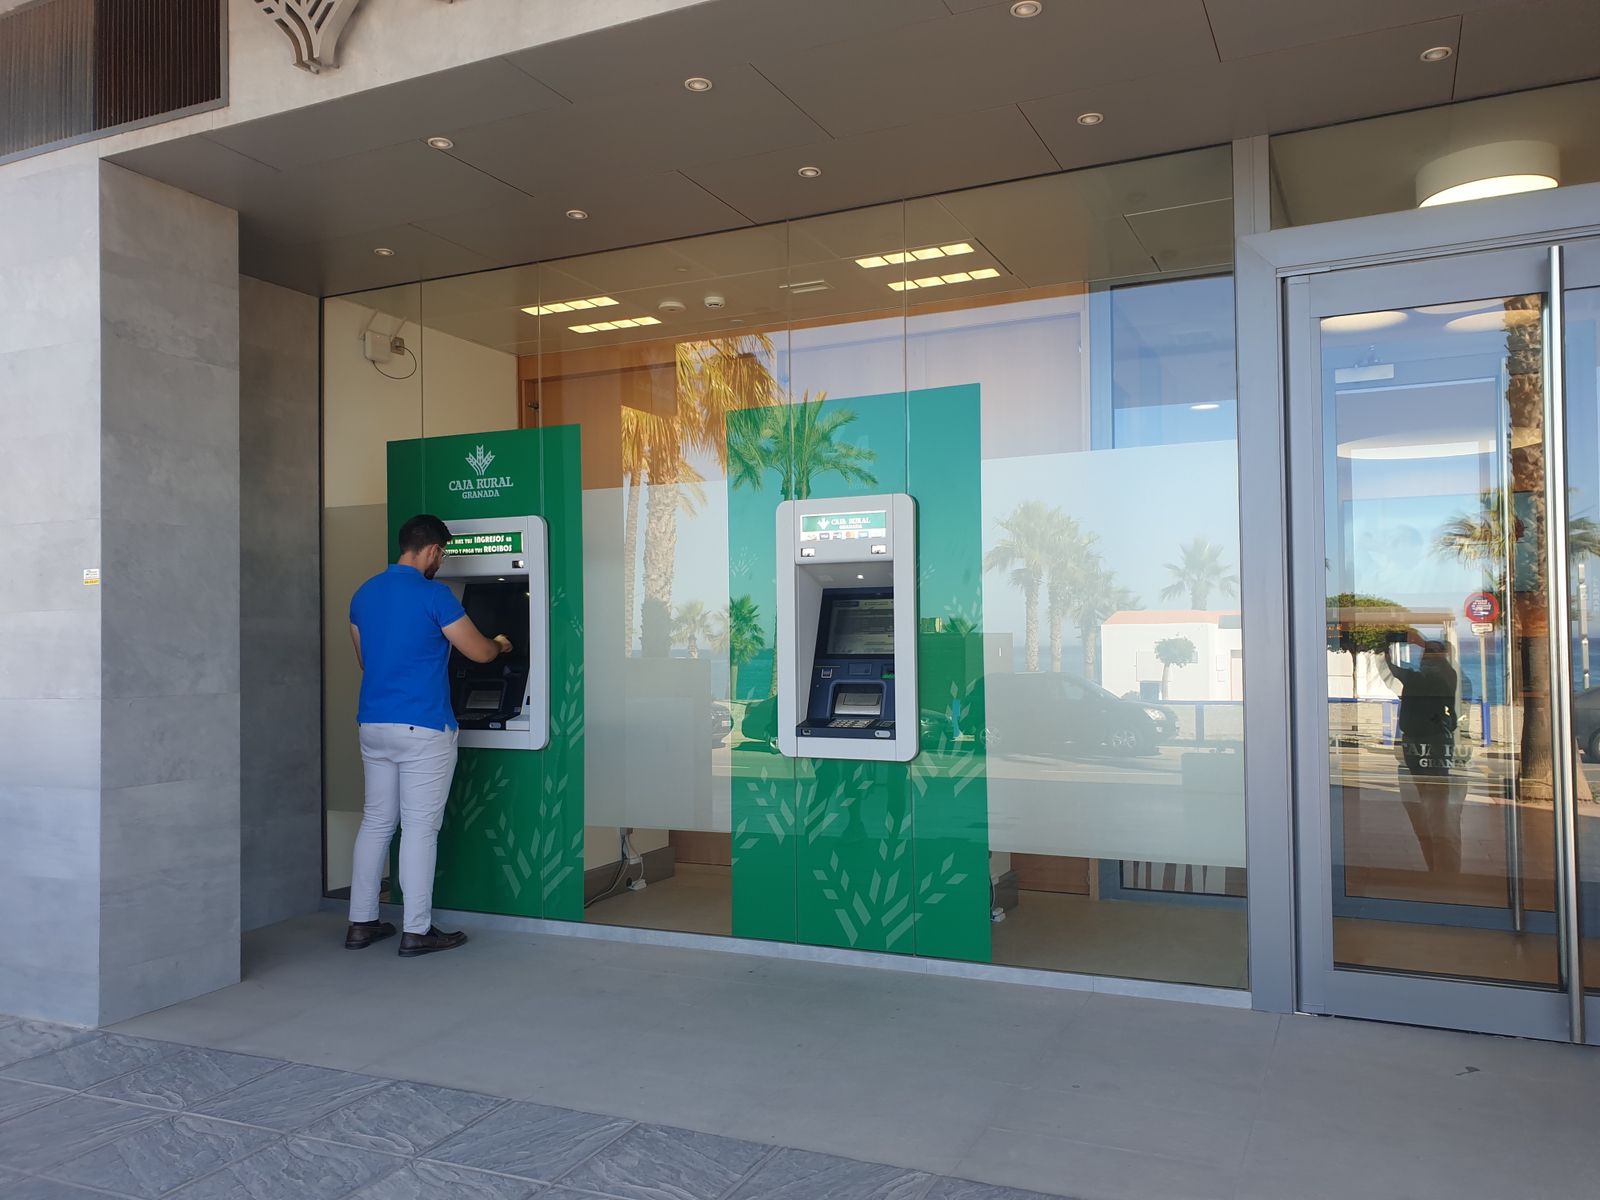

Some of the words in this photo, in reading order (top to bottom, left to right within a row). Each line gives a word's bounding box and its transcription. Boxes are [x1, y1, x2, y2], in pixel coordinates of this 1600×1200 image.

[448, 479, 474, 491] CAJA
[476, 476, 514, 489] RURAL
[462, 489, 500, 499] GRANADA
[474, 535, 505, 543] INGRESOS
[483, 545, 512, 553] RECIBOS
